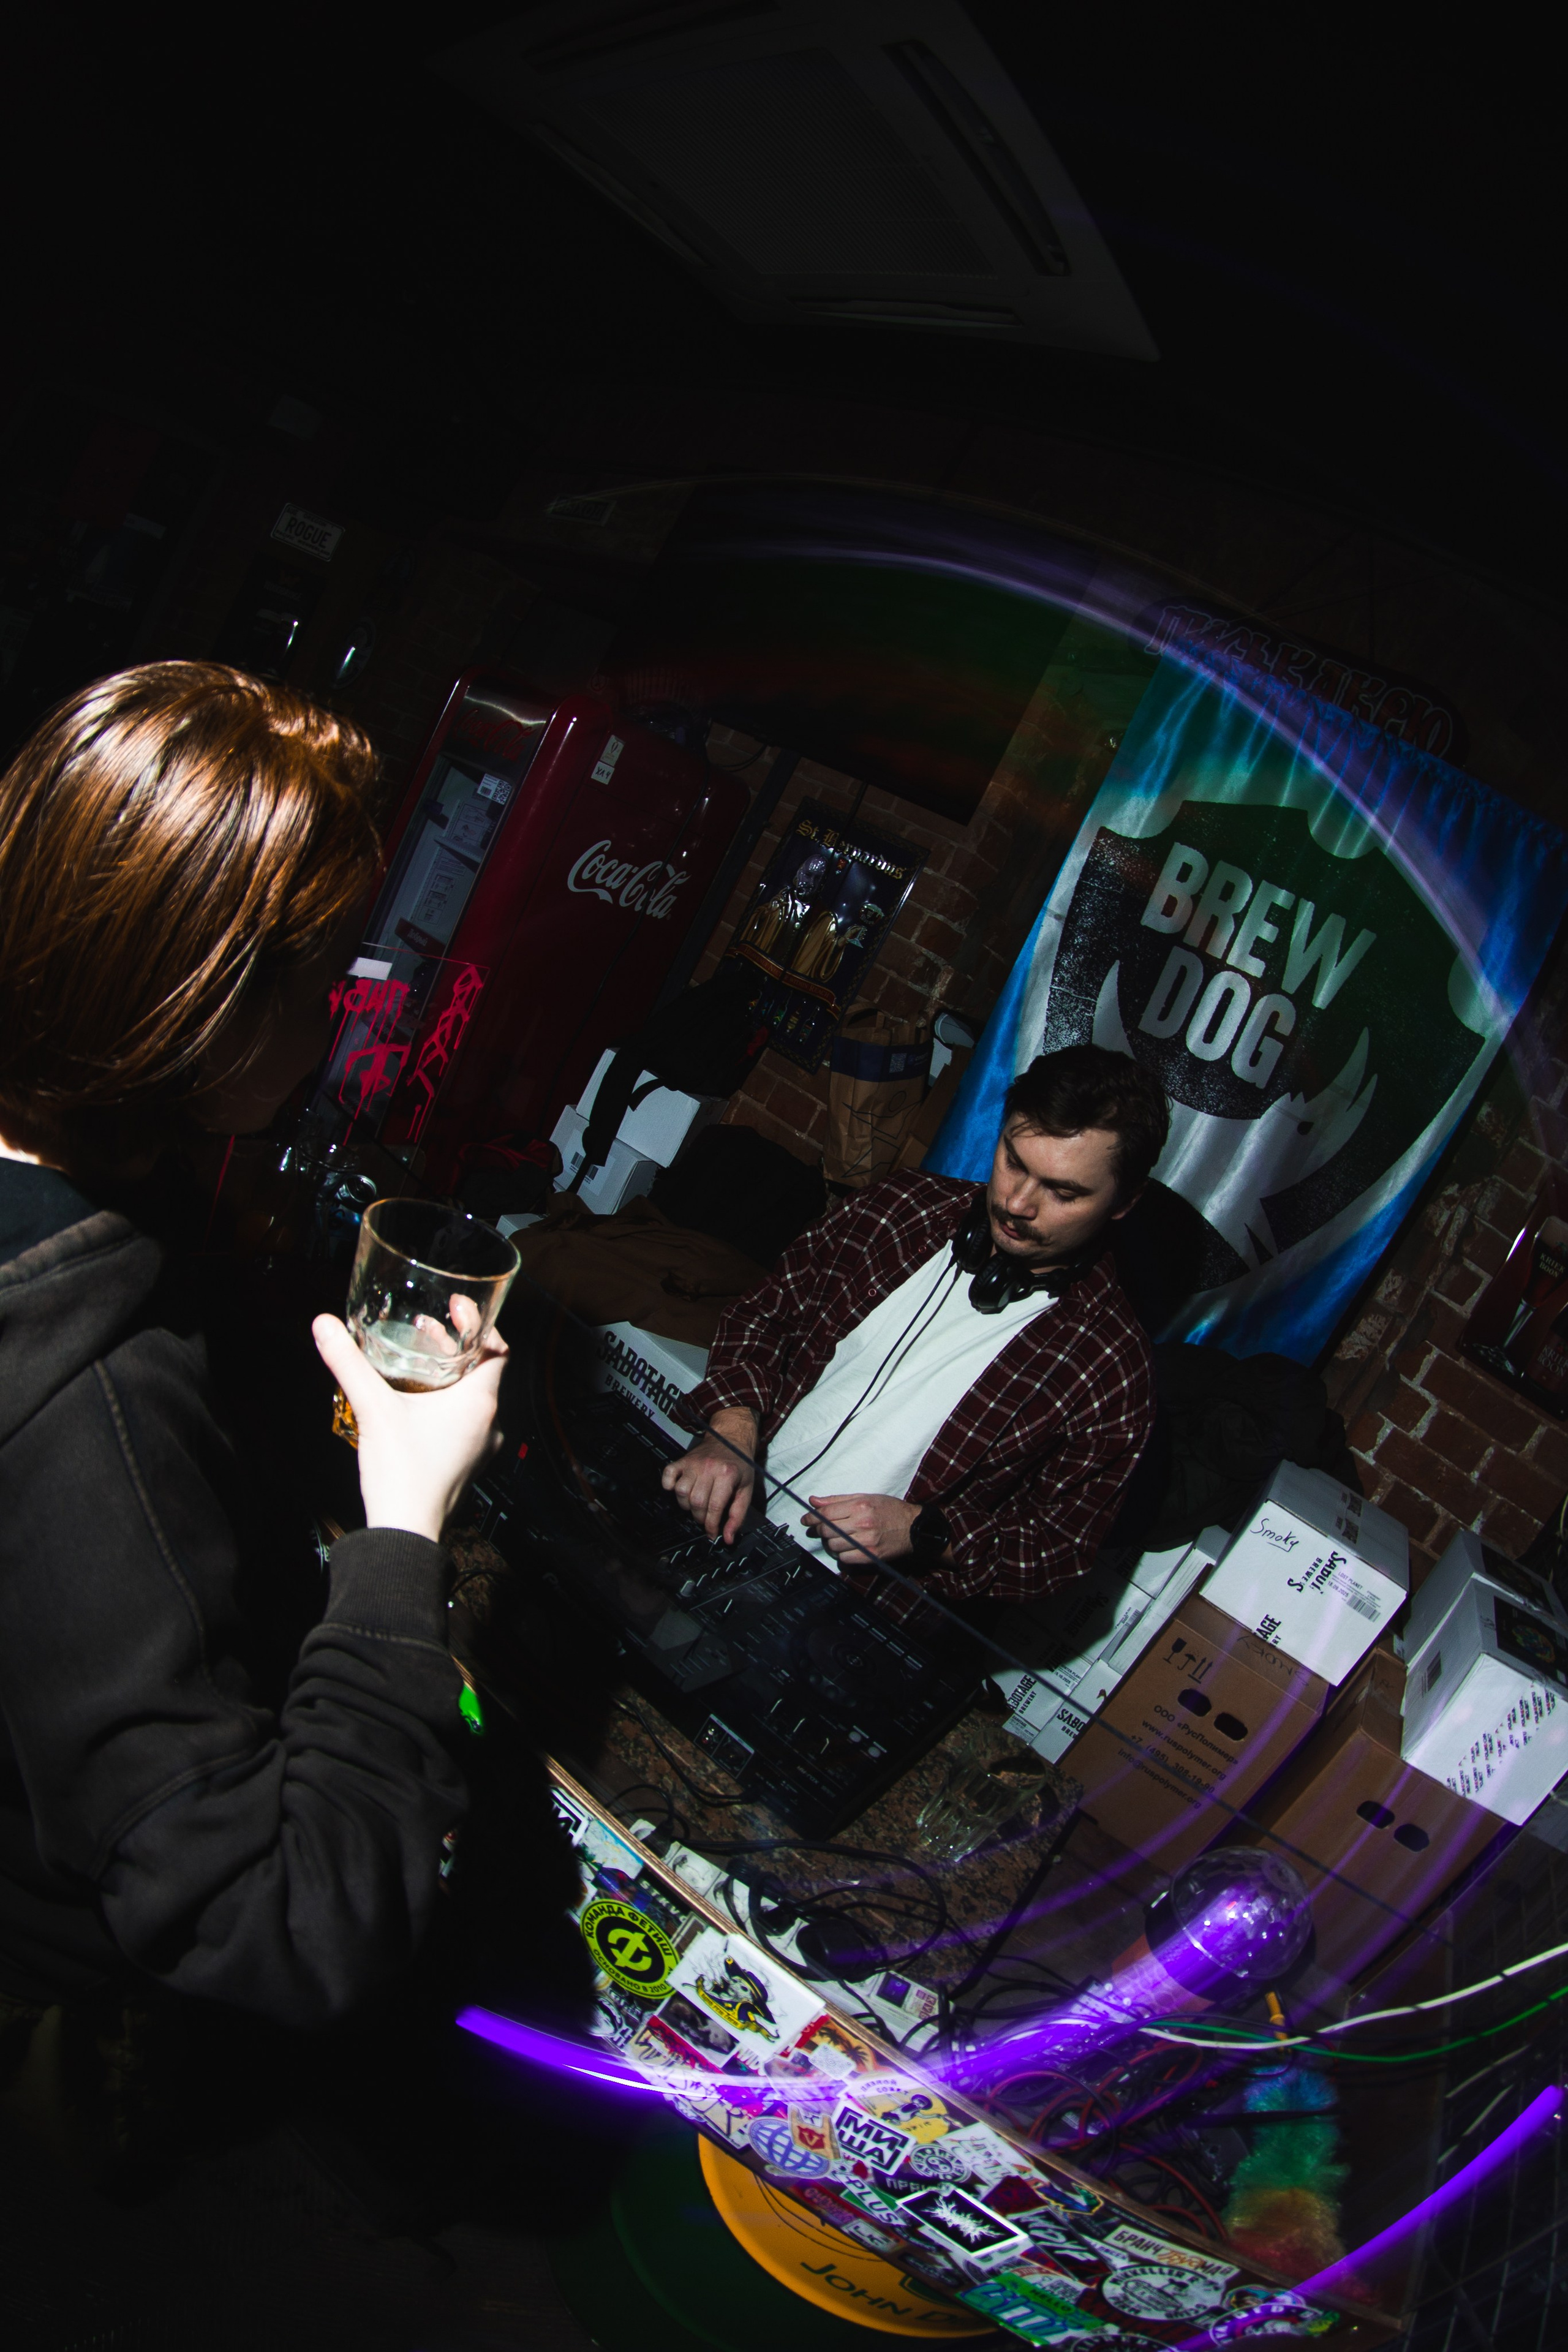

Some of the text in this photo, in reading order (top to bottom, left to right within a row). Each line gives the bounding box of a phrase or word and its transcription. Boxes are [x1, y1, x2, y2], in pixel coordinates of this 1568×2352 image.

[285, 516, 331, 548] ROGUE
[453, 707, 537, 763] Coca-Cola
[567, 839, 692, 919] Coca-Cola
[1139, 842, 1377, 1011] BREW
[809, 984, 831, 998] REACH
[1137, 948, 1298, 1090] DOG
[1539, 1252, 1566, 1273] KRIEK
[1539, 1261, 1559, 1278] BOON
[1537, 1353, 1565, 1377] BOON
[605, 1374, 655, 1419] BREWERY
[1336, 1570, 1364, 1591] LOST PLANET
[1006, 1674, 1038, 1712] ABOTAGE
[1018, 1690, 1037, 1715] BREWERY
[1142, 1719, 1227, 1782] www.ruspolymer.org
[1153, 1705, 1238, 1767] ООО «РусПолимер»
[1118, 1747, 1202, 1809] info@ruspolymer.org
[1131, 1733, 1216, 1795] +7 (495) 308-19-90
[585, 1905, 673, 1956] КОМАНДА ФЕТИШ
[593, 1949, 641, 1989] ОСНОВАНО
[650, 1984, 666, 1993] 2010
[838, 2129, 884, 2164] ША
[843, 2115, 899, 2151] МИ
[846, 2176, 899, 2223] PLUS
[1113, 2230, 1164, 2255] БРАНЧ
[800, 2262, 913, 2316] JOHN
[1030, 2288, 1072, 2312] HELLO
